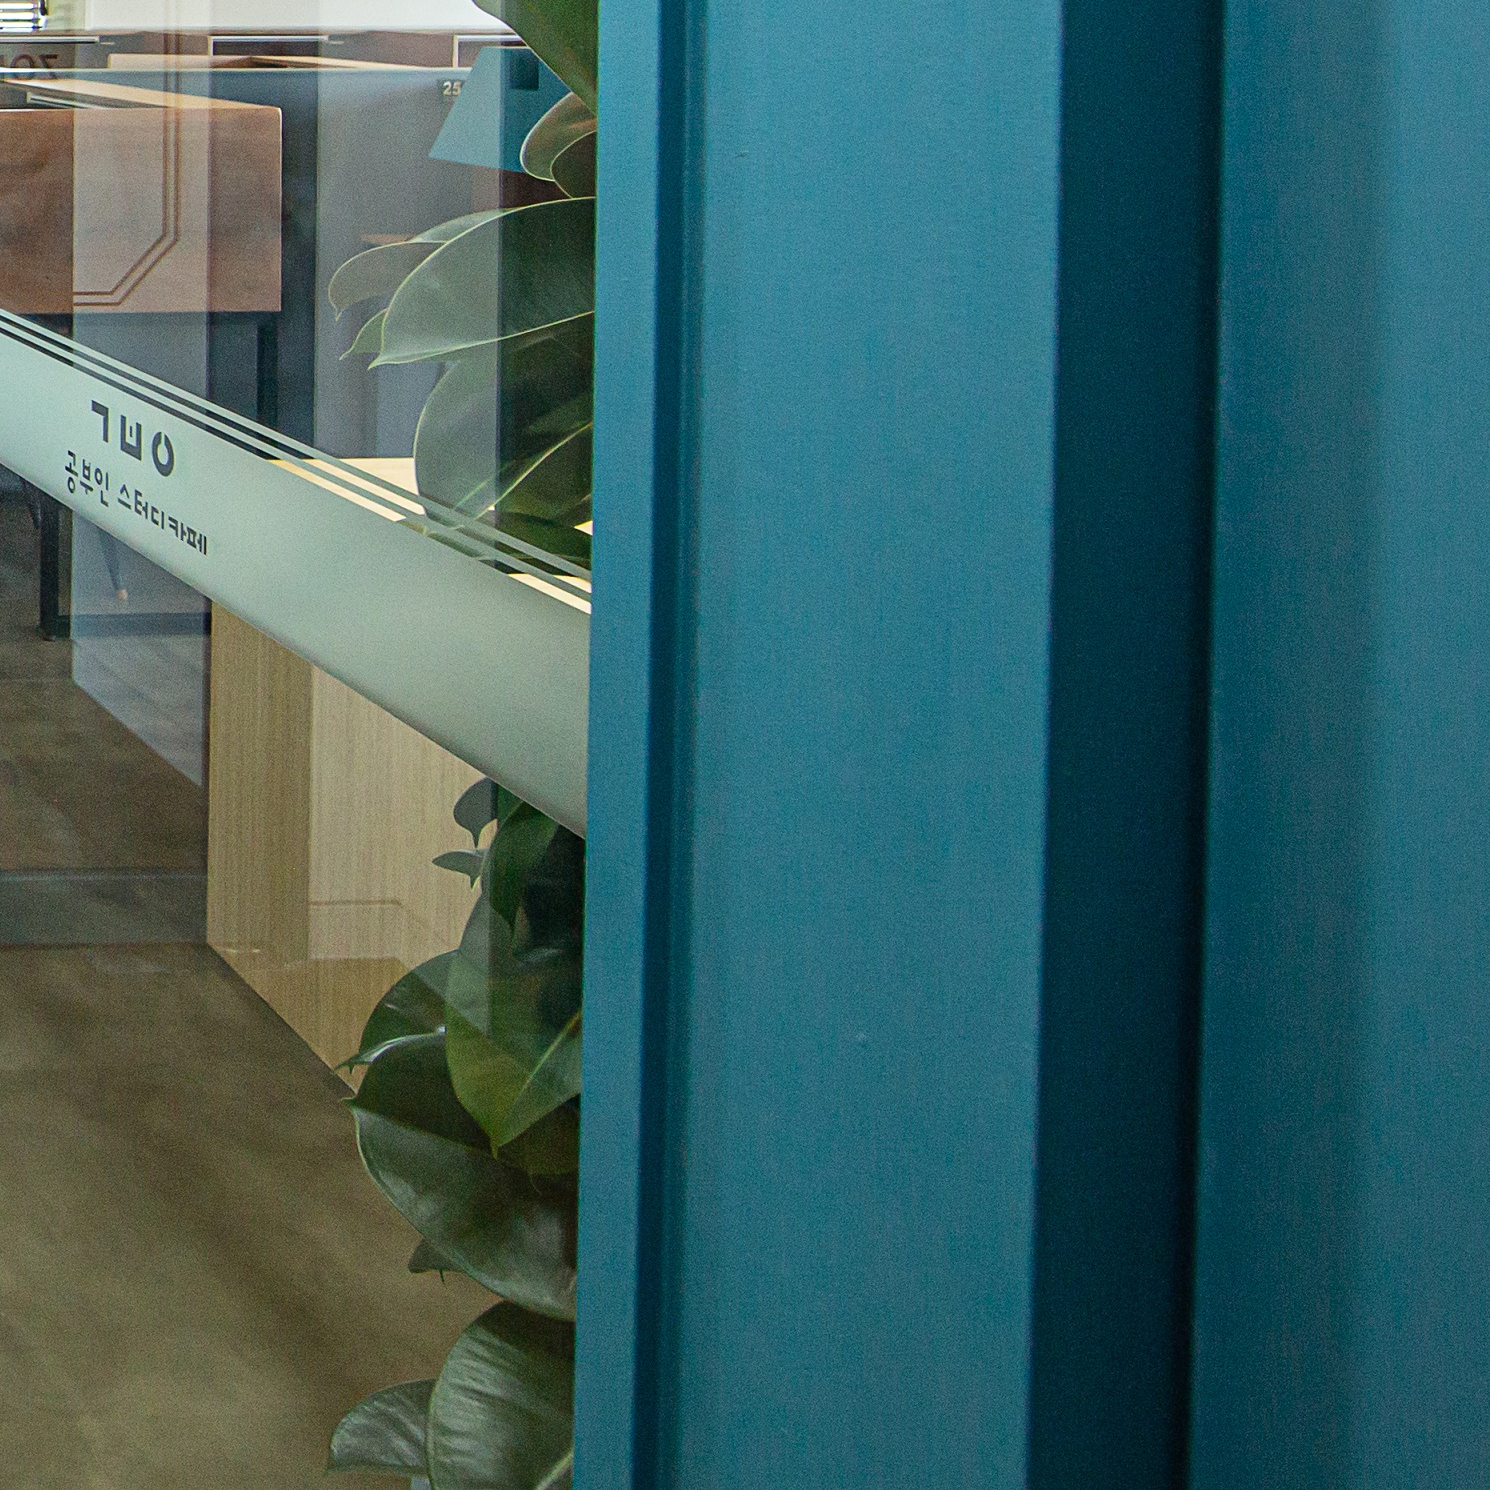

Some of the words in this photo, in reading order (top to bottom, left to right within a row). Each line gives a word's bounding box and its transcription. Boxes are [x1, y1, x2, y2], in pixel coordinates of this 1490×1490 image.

[443, 80, 461, 96] 25
[64, 449, 109, 508] 공부인
[117, 483, 208, 556] 스터디카페
